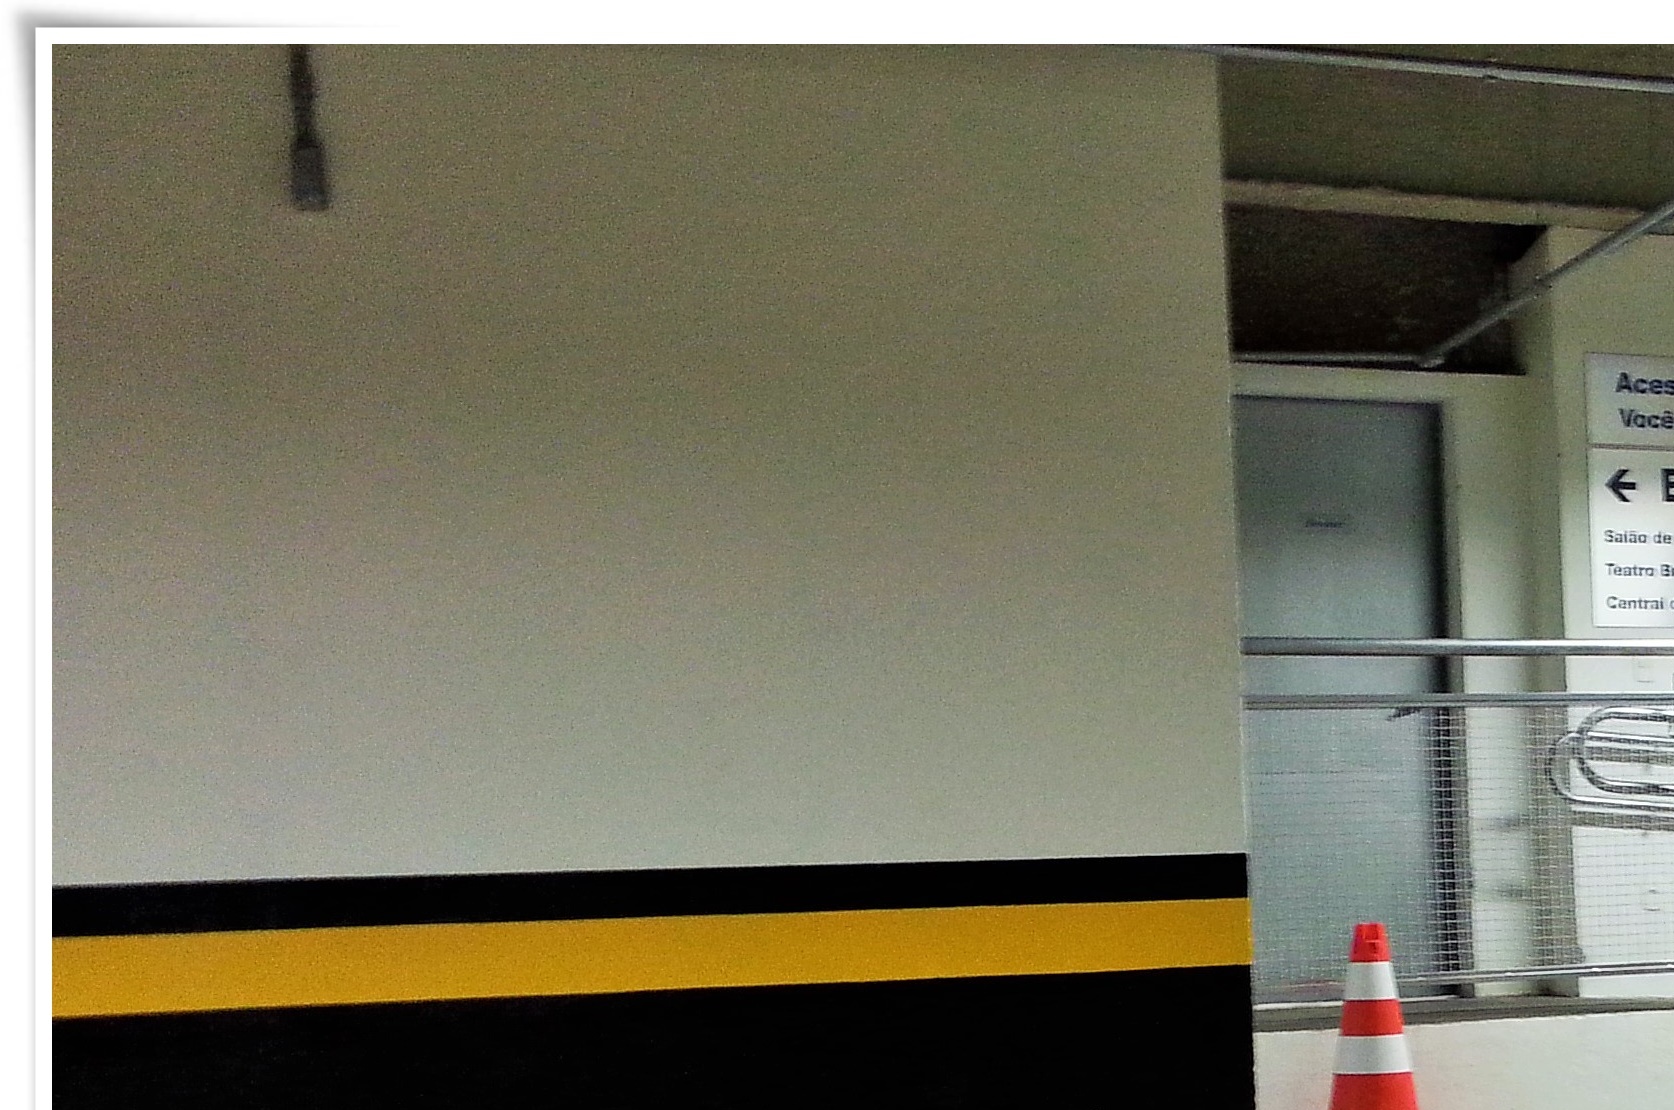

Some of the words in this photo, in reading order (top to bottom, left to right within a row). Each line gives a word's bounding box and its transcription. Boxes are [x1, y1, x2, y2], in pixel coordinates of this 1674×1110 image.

[1618, 408, 1674, 429] Você
[1604, 529, 1647, 544] Salão
[1653, 531, 1672, 545] de
[1605, 562, 1654, 577] Teatro
[1606, 595, 1664, 610] Central
